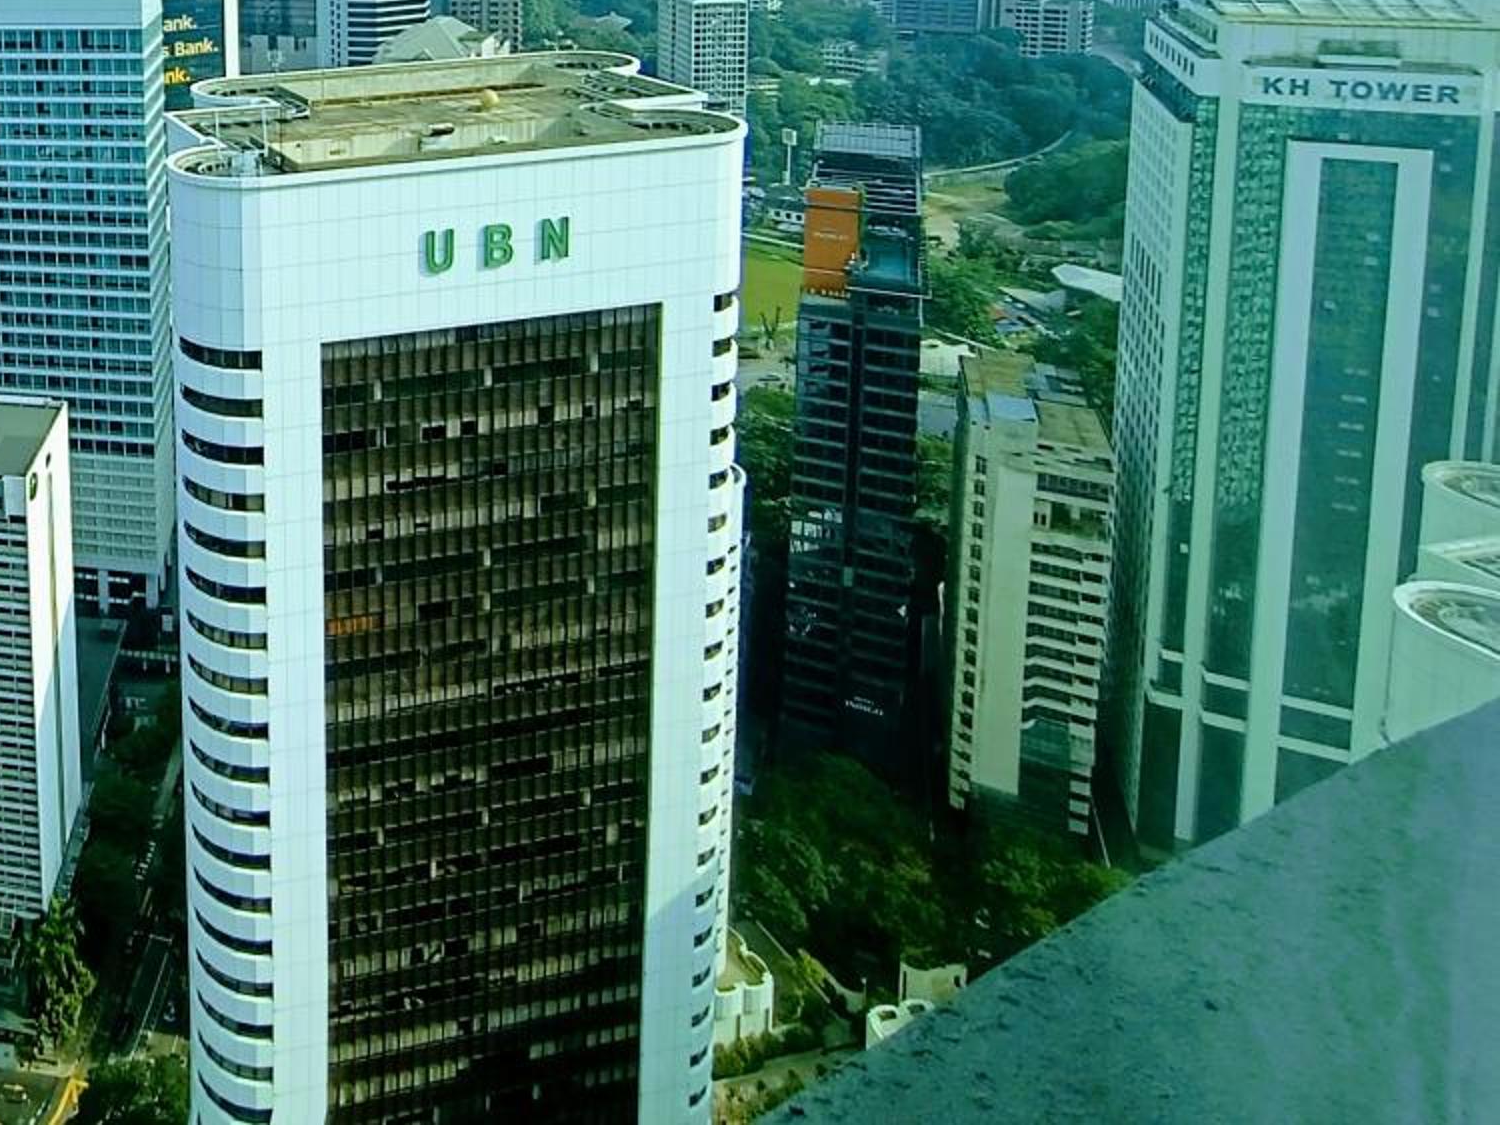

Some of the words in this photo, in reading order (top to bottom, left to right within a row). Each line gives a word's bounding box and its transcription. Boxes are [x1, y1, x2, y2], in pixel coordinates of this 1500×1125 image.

[174, 37, 219, 57] Bank.
[1263, 77, 1310, 96] KH
[1329, 79, 1461, 104] TOWER
[422, 216, 570, 275] UBN
